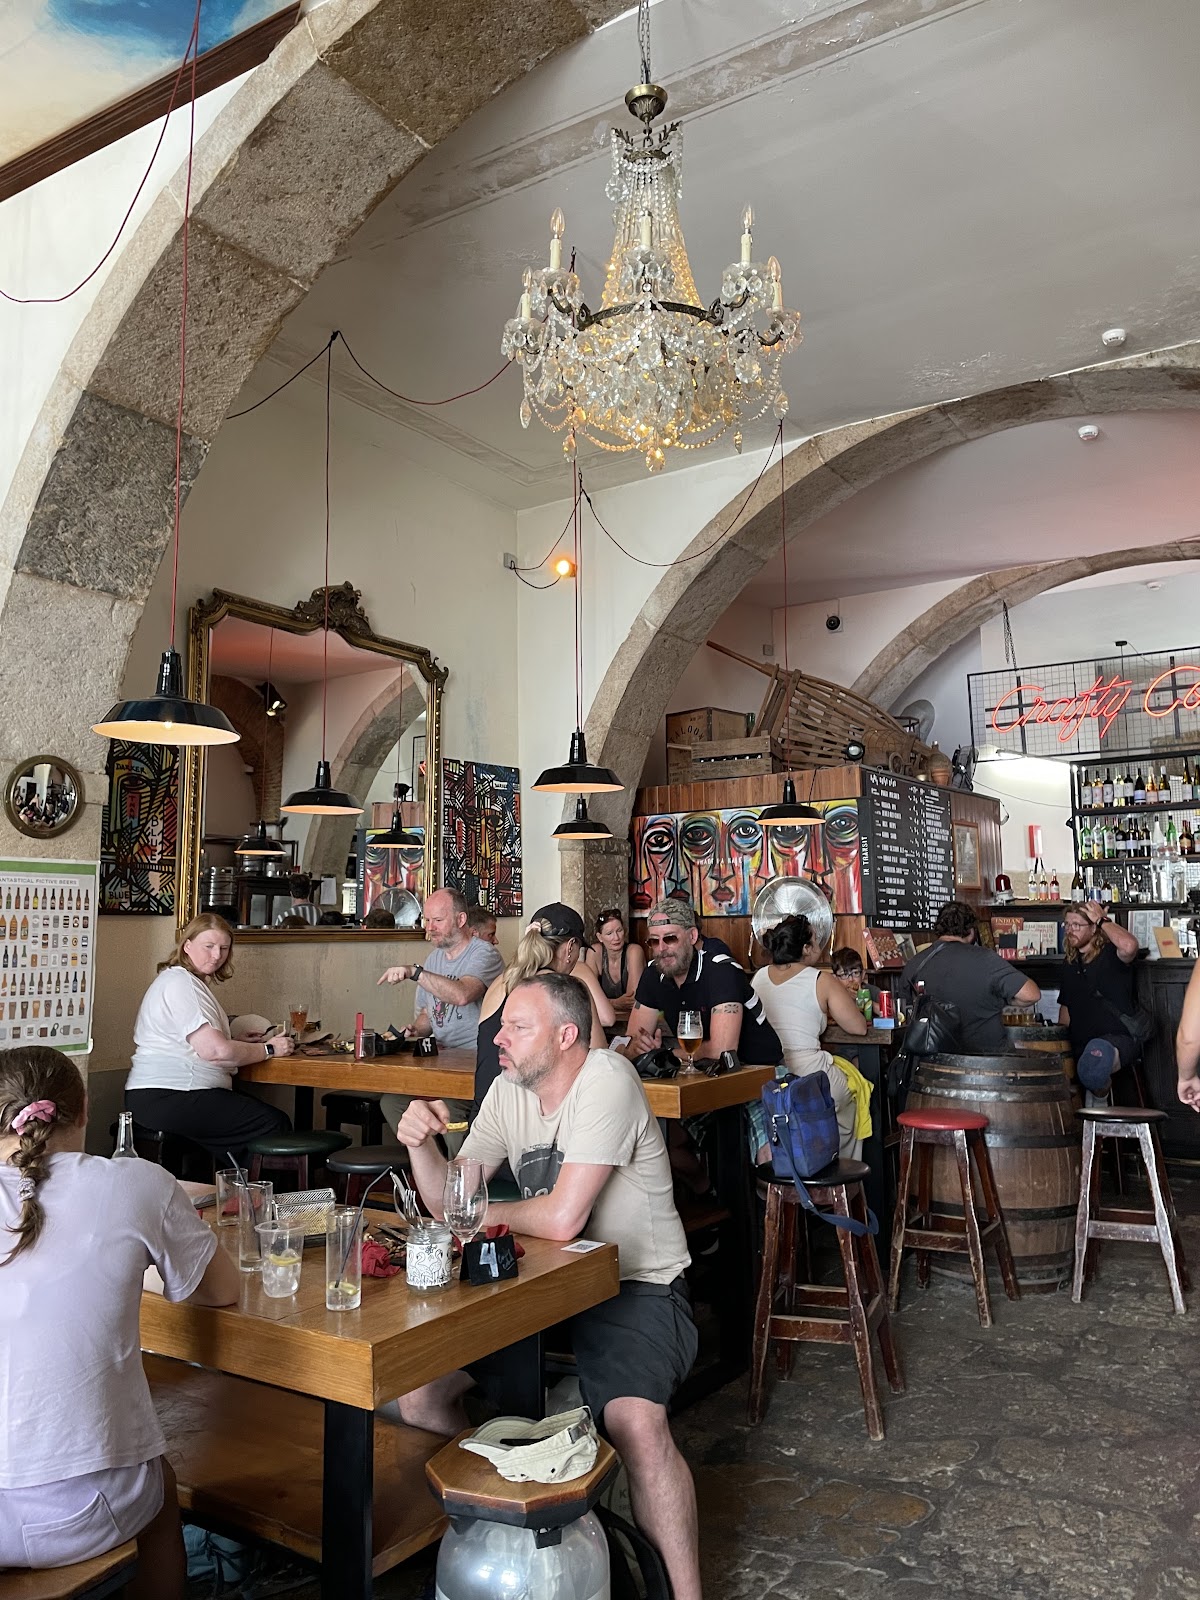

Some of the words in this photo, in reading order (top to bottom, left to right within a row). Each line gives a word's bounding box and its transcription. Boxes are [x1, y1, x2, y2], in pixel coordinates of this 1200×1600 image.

[992, 674, 1133, 743] Crafty
[115, 762, 147, 775] DARKER
[150, 815, 159, 861] BLUE
[861, 836, 870, 865] TRANSIT
[863, 867, 870, 876] IN
[108, 890, 131, 900] BLUE
[479, 1241, 500, 1278] 4
